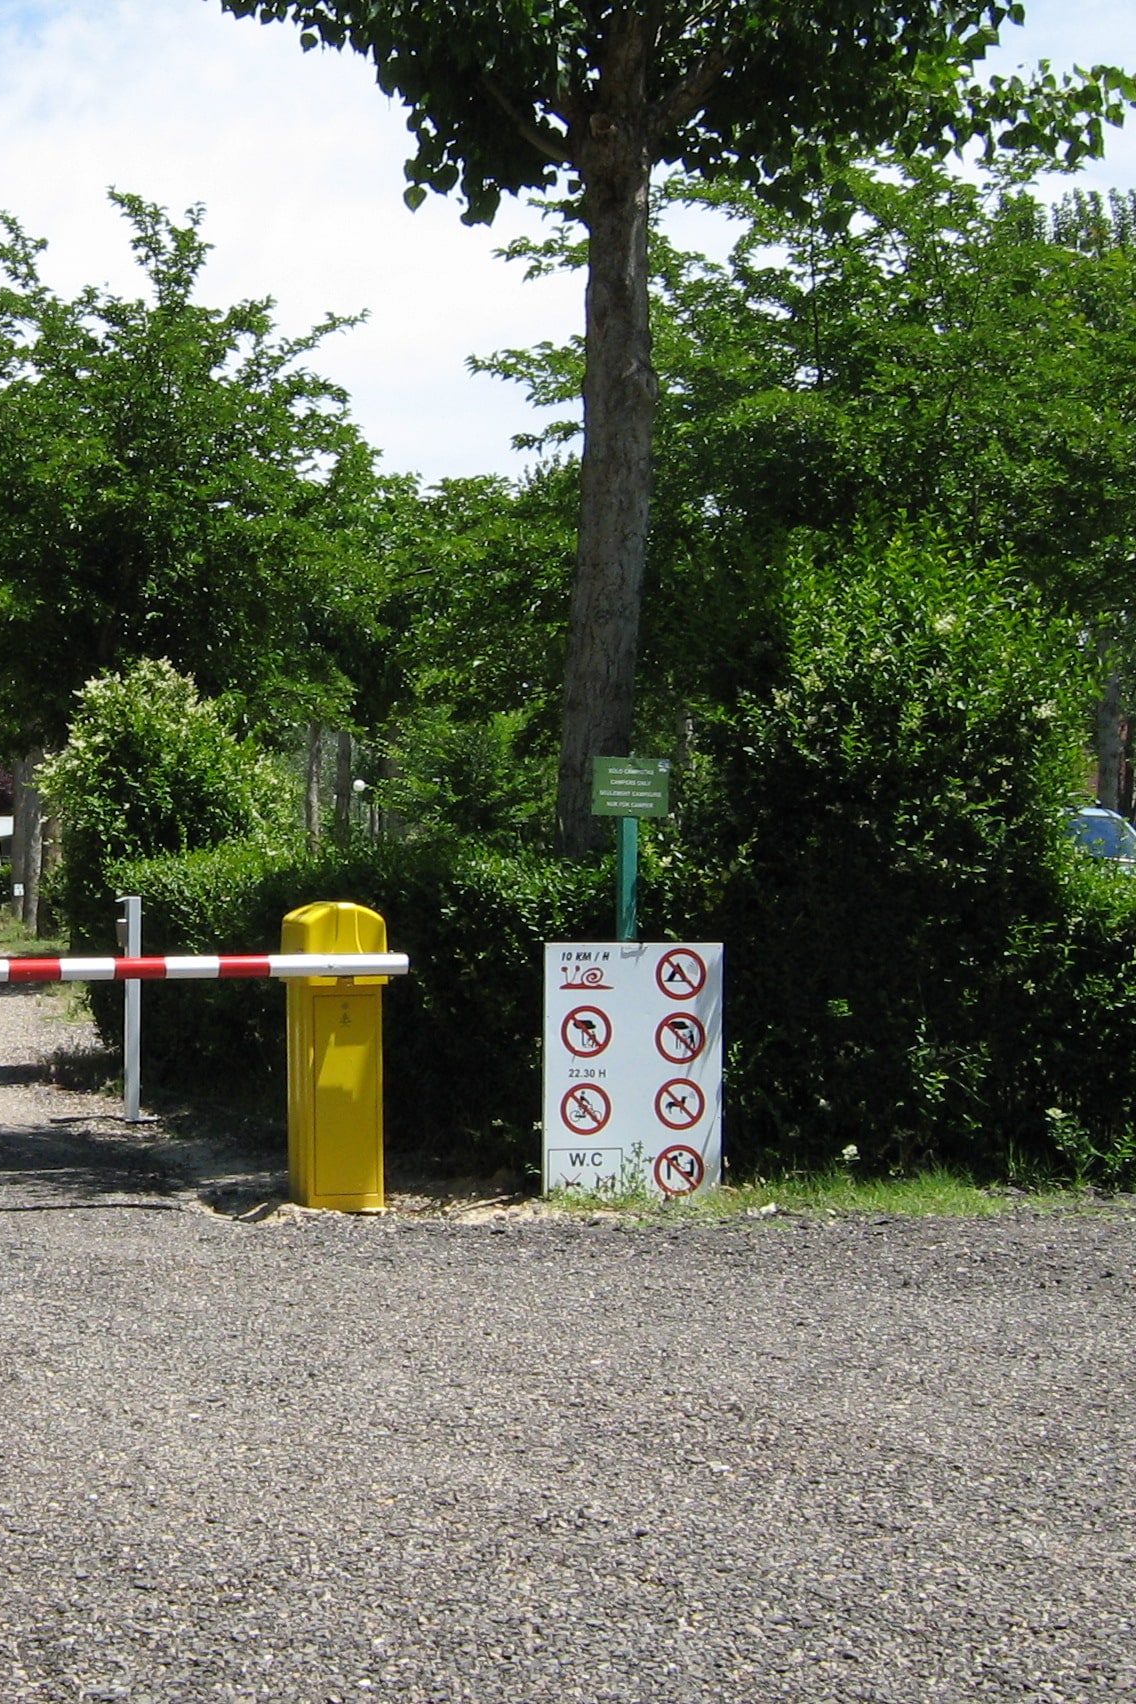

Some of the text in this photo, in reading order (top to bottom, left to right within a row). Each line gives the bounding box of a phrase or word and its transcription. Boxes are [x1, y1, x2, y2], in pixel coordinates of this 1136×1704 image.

[562, 952, 573, 961] 10
[568, 1068, 606, 1078] 22.30 H
[569, 1152, 603, 1167] W.C
